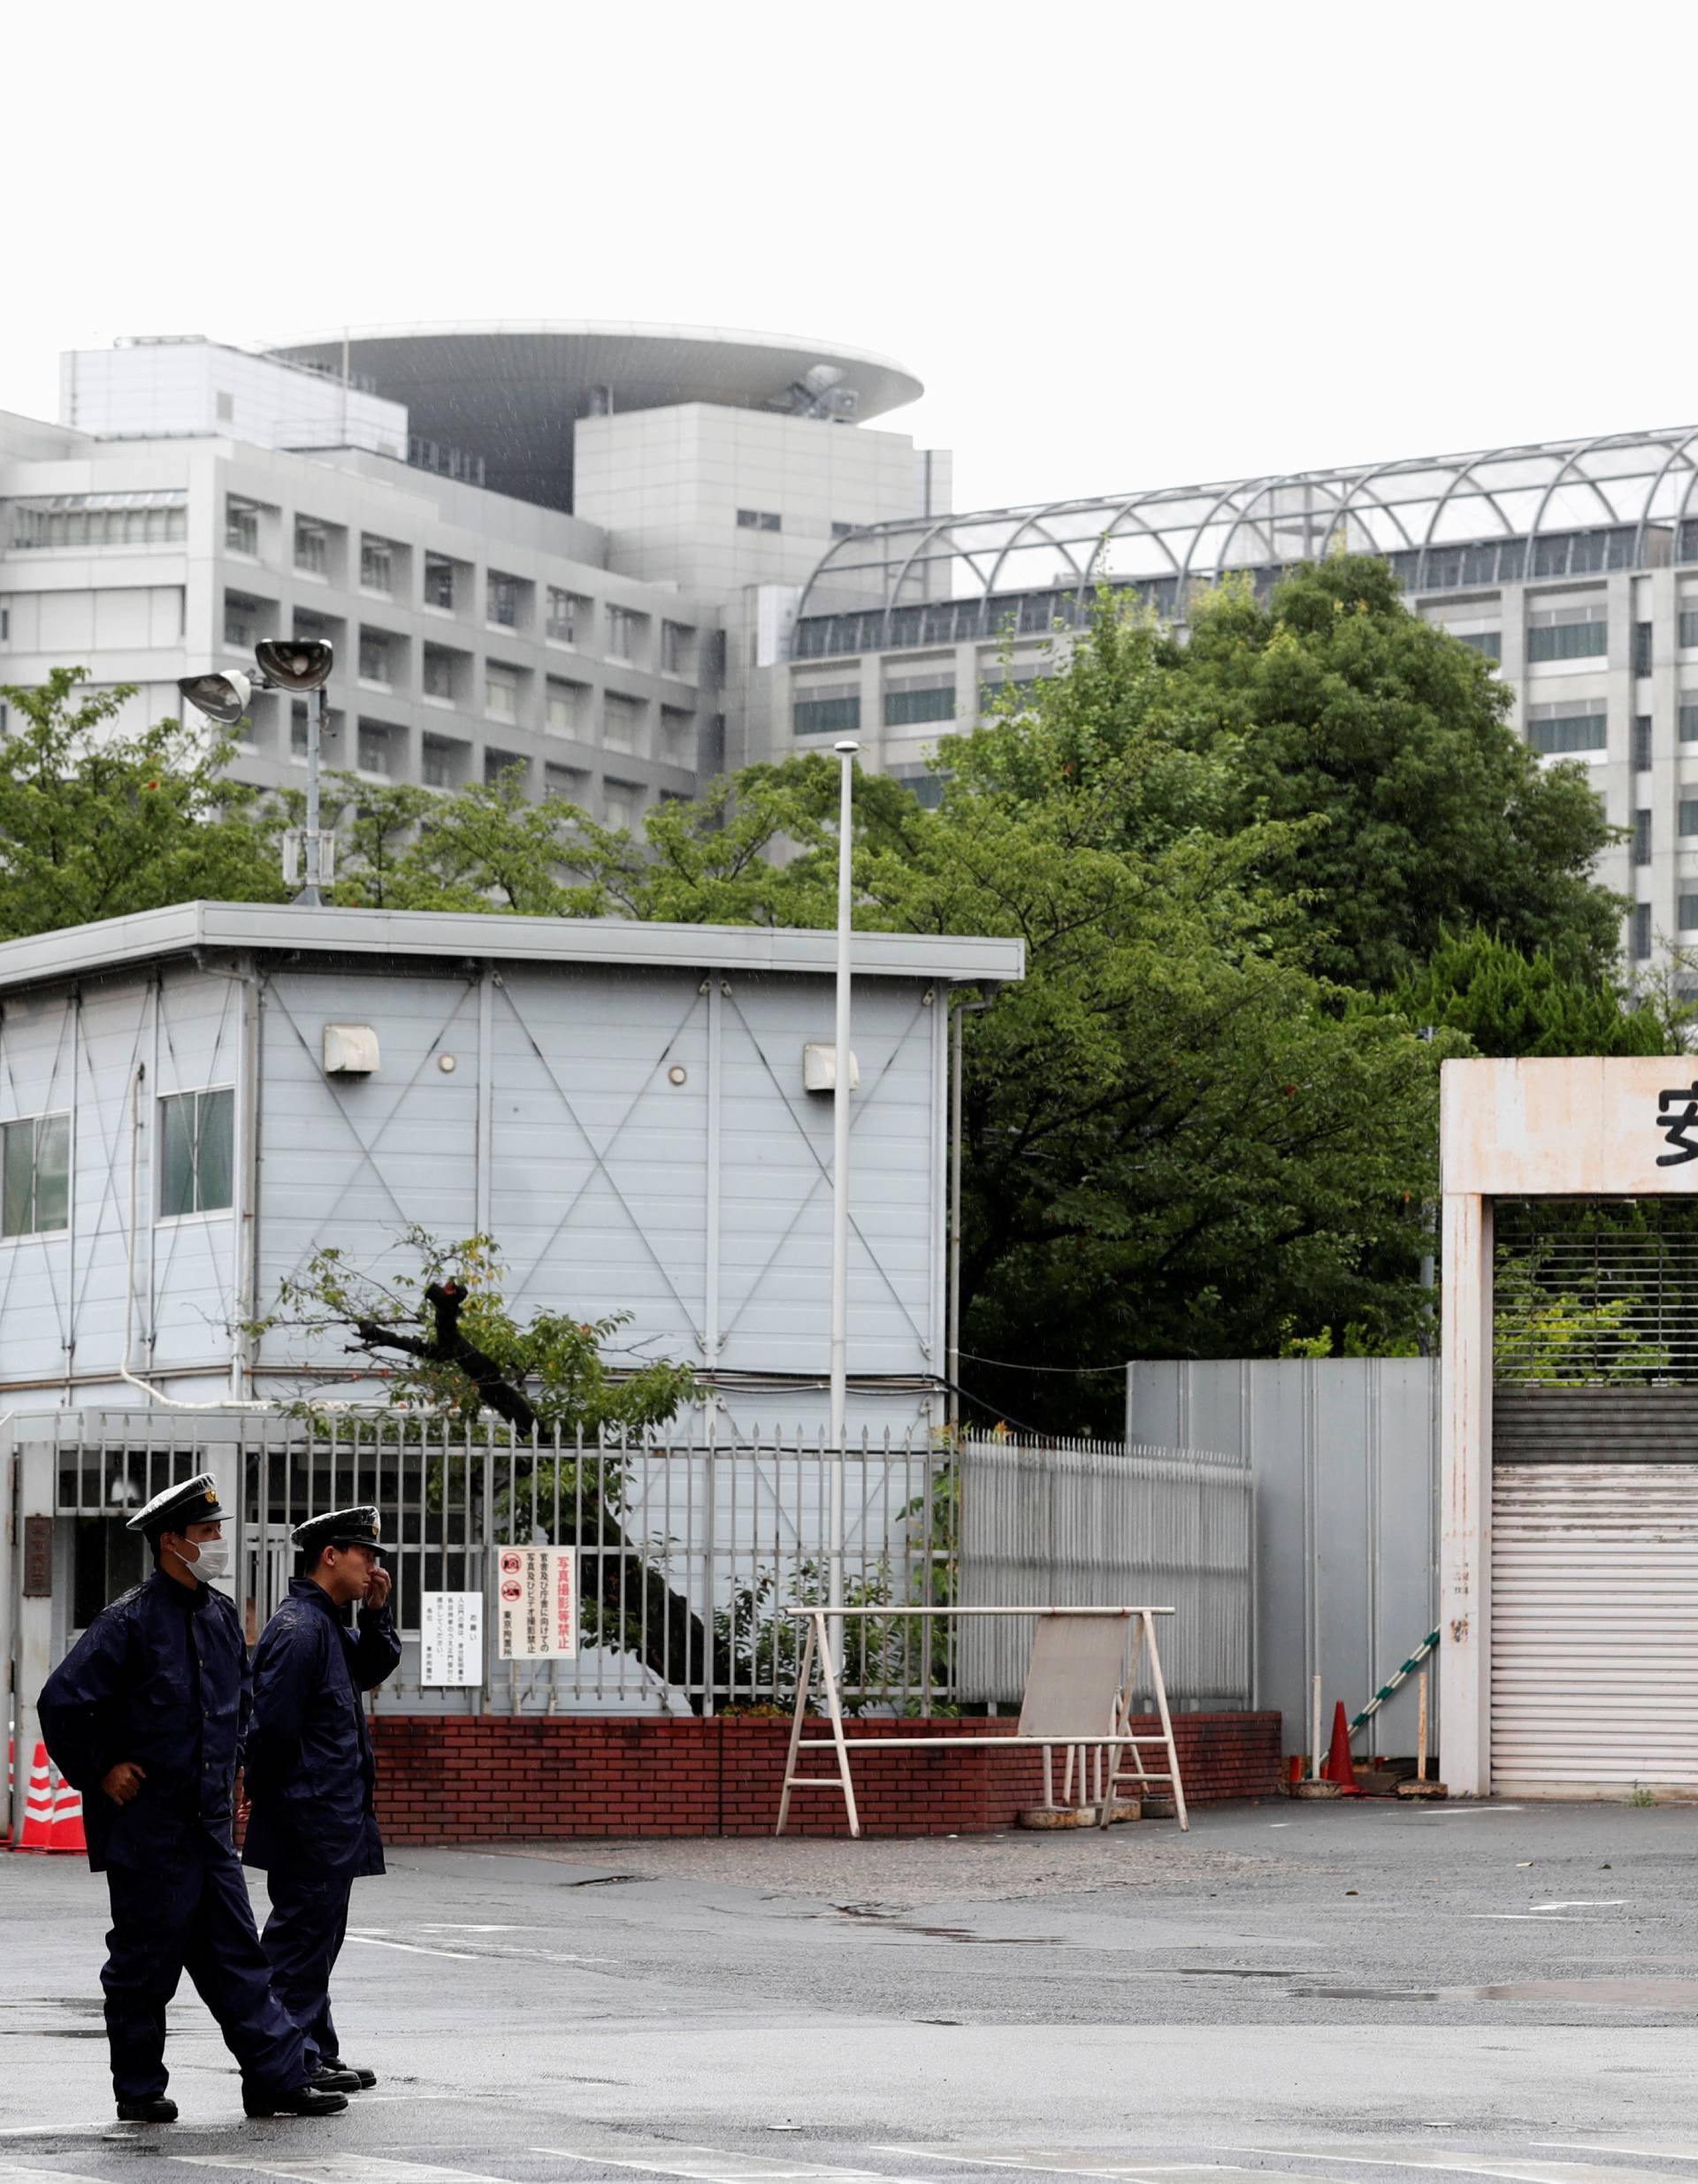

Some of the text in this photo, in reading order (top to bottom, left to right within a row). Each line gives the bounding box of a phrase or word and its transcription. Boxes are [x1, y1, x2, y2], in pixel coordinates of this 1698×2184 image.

[503, 1610, 512, 1656] 東京拘置所
[526, 1553, 536, 1653] 写真及びビデオ撮影禁止
[557, 1556, 570, 1650] 写真撮影等禁止
